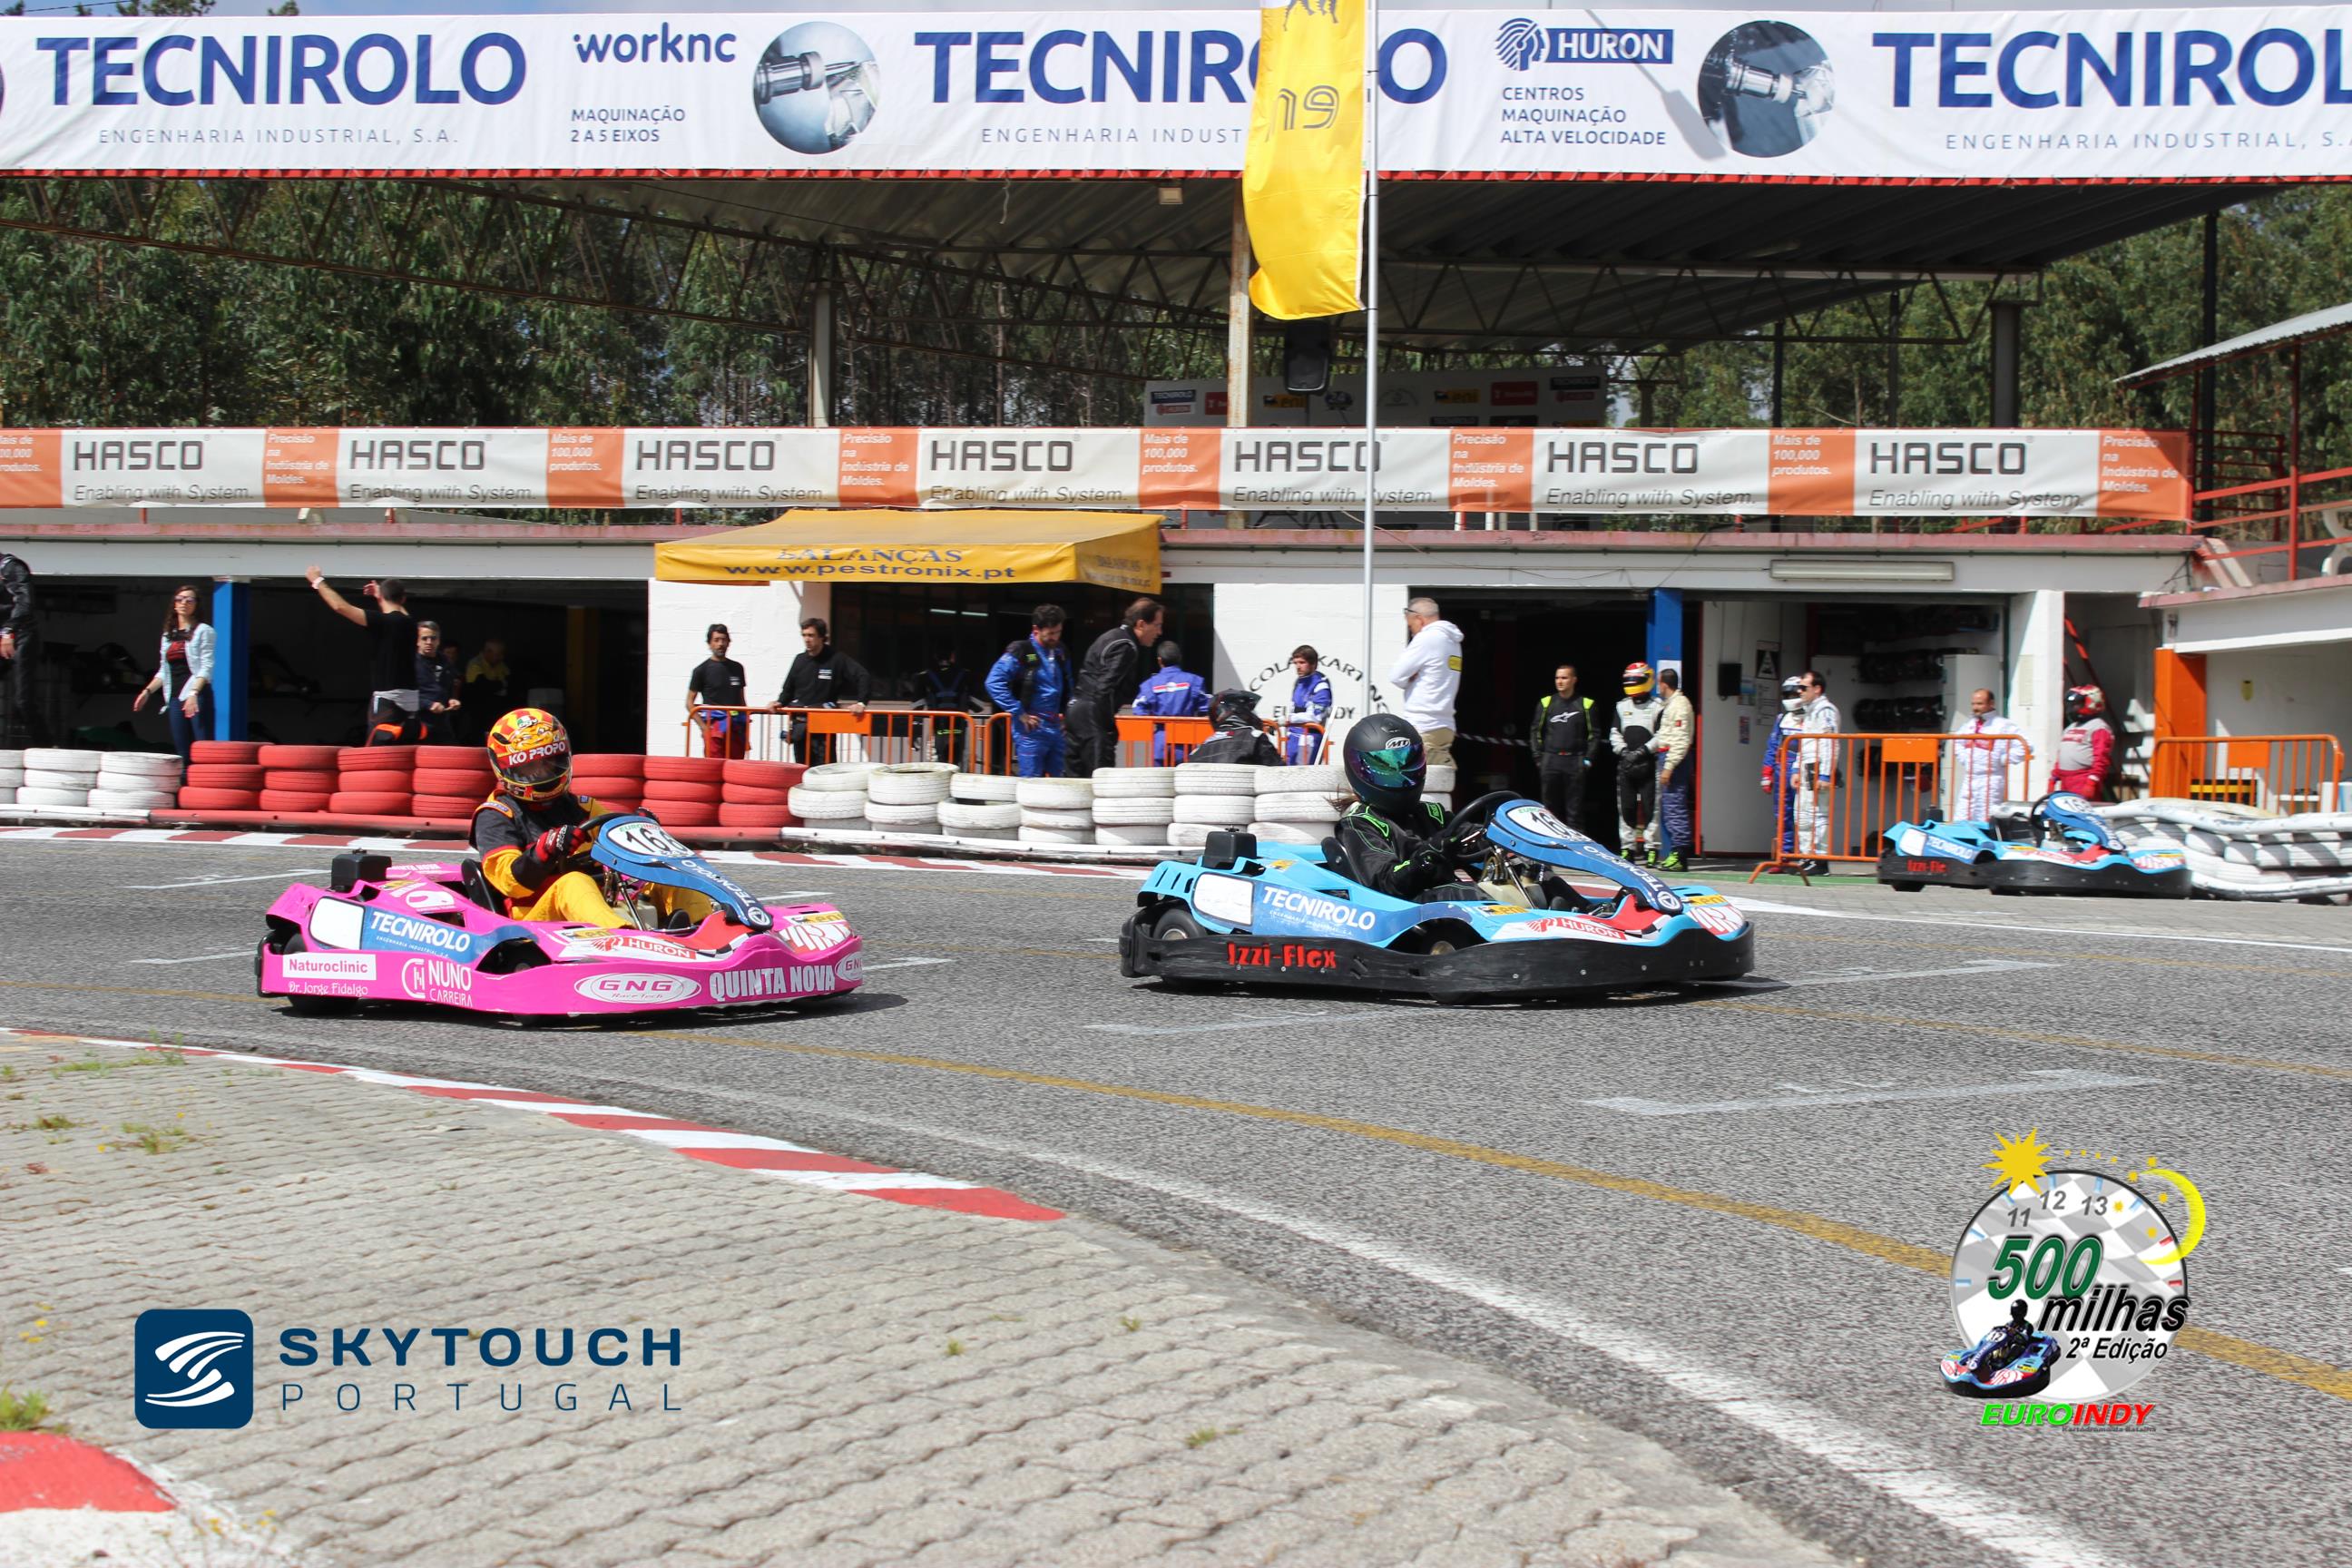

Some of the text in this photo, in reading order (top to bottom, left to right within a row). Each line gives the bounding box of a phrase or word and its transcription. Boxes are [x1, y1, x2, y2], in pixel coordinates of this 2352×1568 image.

[573, 22, 737, 63] worknc
[1558, 33, 1664, 60] HURON
[36, 32, 526, 107] TECNIROLO
[915, 28, 1449, 104] TECNIRO
[1873, 28, 2352, 109] TECNIROL
[1502, 87, 1584, 101] CENTROS
[571, 105, 686, 125] MAQUINAÇÃO
[1502, 106, 1627, 127] MAQUINAÇÃO
[100, 128, 458, 145] ENGENHARIA INDUSTRIAL, S.A.
[571, 130, 660, 142] 2 A 5 EIXOS
[982, 127, 1242, 143] ENGENHARIA INDUST
[1501, 131, 1666, 145] ALTA VELOCIDADE
[1946, 133, 2119, 150] ENGENHARIA
[2133, 132, 2306, 151] INDUSTRIAL,
[268, 433, 315, 444] Precisão
[551, 433, 593, 444] Mais de
[842, 433, 892, 445] Precisão
[1143, 433, 1188, 445] Mais de
[1454, 434, 1506, 446] Precisão
[1773, 434, 1821, 446] Mais de
[2102, 436, 2158, 448] Precisão
[74, 441, 204, 471] HASCO
[350, 440, 485, 471] HASCO
[551, 447, 593, 458] 100,000
[637, 440, 774, 471] HASCO
[842, 449, 856, 458] na
[930, 441, 1073, 472] HASCO
[1144, 447, 1188, 460] 100,000
[1235, 441, 1380, 473] HASCO
[1453, 450, 1468, 459] na
[1548, 441, 1699, 474] HASCO
[1773, 450, 1820, 462] 100,000
[1870, 442, 2026, 475] HASCO
[2102, 452, 2119, 461] na
[315, 460, 328, 470] de
[549, 462, 602, 473] produtos.
[841, 461, 909, 472] Indústria de
[1142, 462, 1199, 475] produtos.
[1453, 461, 1524, 474] Indústria de
[1772, 464, 1831, 476] produtos.
[2102, 466, 2178, 479] Indústria de
[266, 474, 308, 485] Moldes.
[840, 475, 885, 486] Moldes.
[1452, 475, 1498, 488] Moldes.
[2102, 481, 2151, 494] Moldes.
[74, 485, 254, 503] Enabling with System.
[349, 484, 536, 502] Enabling with System.
[636, 485, 828, 504] Enabling with System.
[929, 485, 1128, 505] Enabling with System.
[1234, 486, 1313, 505] Enabling
[1318, 487, 1357, 503] with
[1545, 488, 1757, 508] Enabling with System.
[1869, 489, 2085, 511] Enabling with System.
[777, 549, 963, 564] BALANÇAS
[724, 562, 1016, 580] www.pestronix.pt
[509, 742, 565, 766] KO PROPO
[1262, 886, 1377, 931] TECNIROLO
[370, 910, 471, 952] TECNIROLO
[1563, 918, 1622, 939] HURON
[628, 937, 691, 958] HURON
[289, 958, 368, 974] Naturoclinic
[428, 960, 472, 991] NUNO
[710, 965, 836, 1002] QUINTA NOVA
[289, 982, 368, 997] Dr. Jorge Fidalgo
[599, 980, 674, 992] GNG
[430, 988, 473, 1008] CARREIRA
